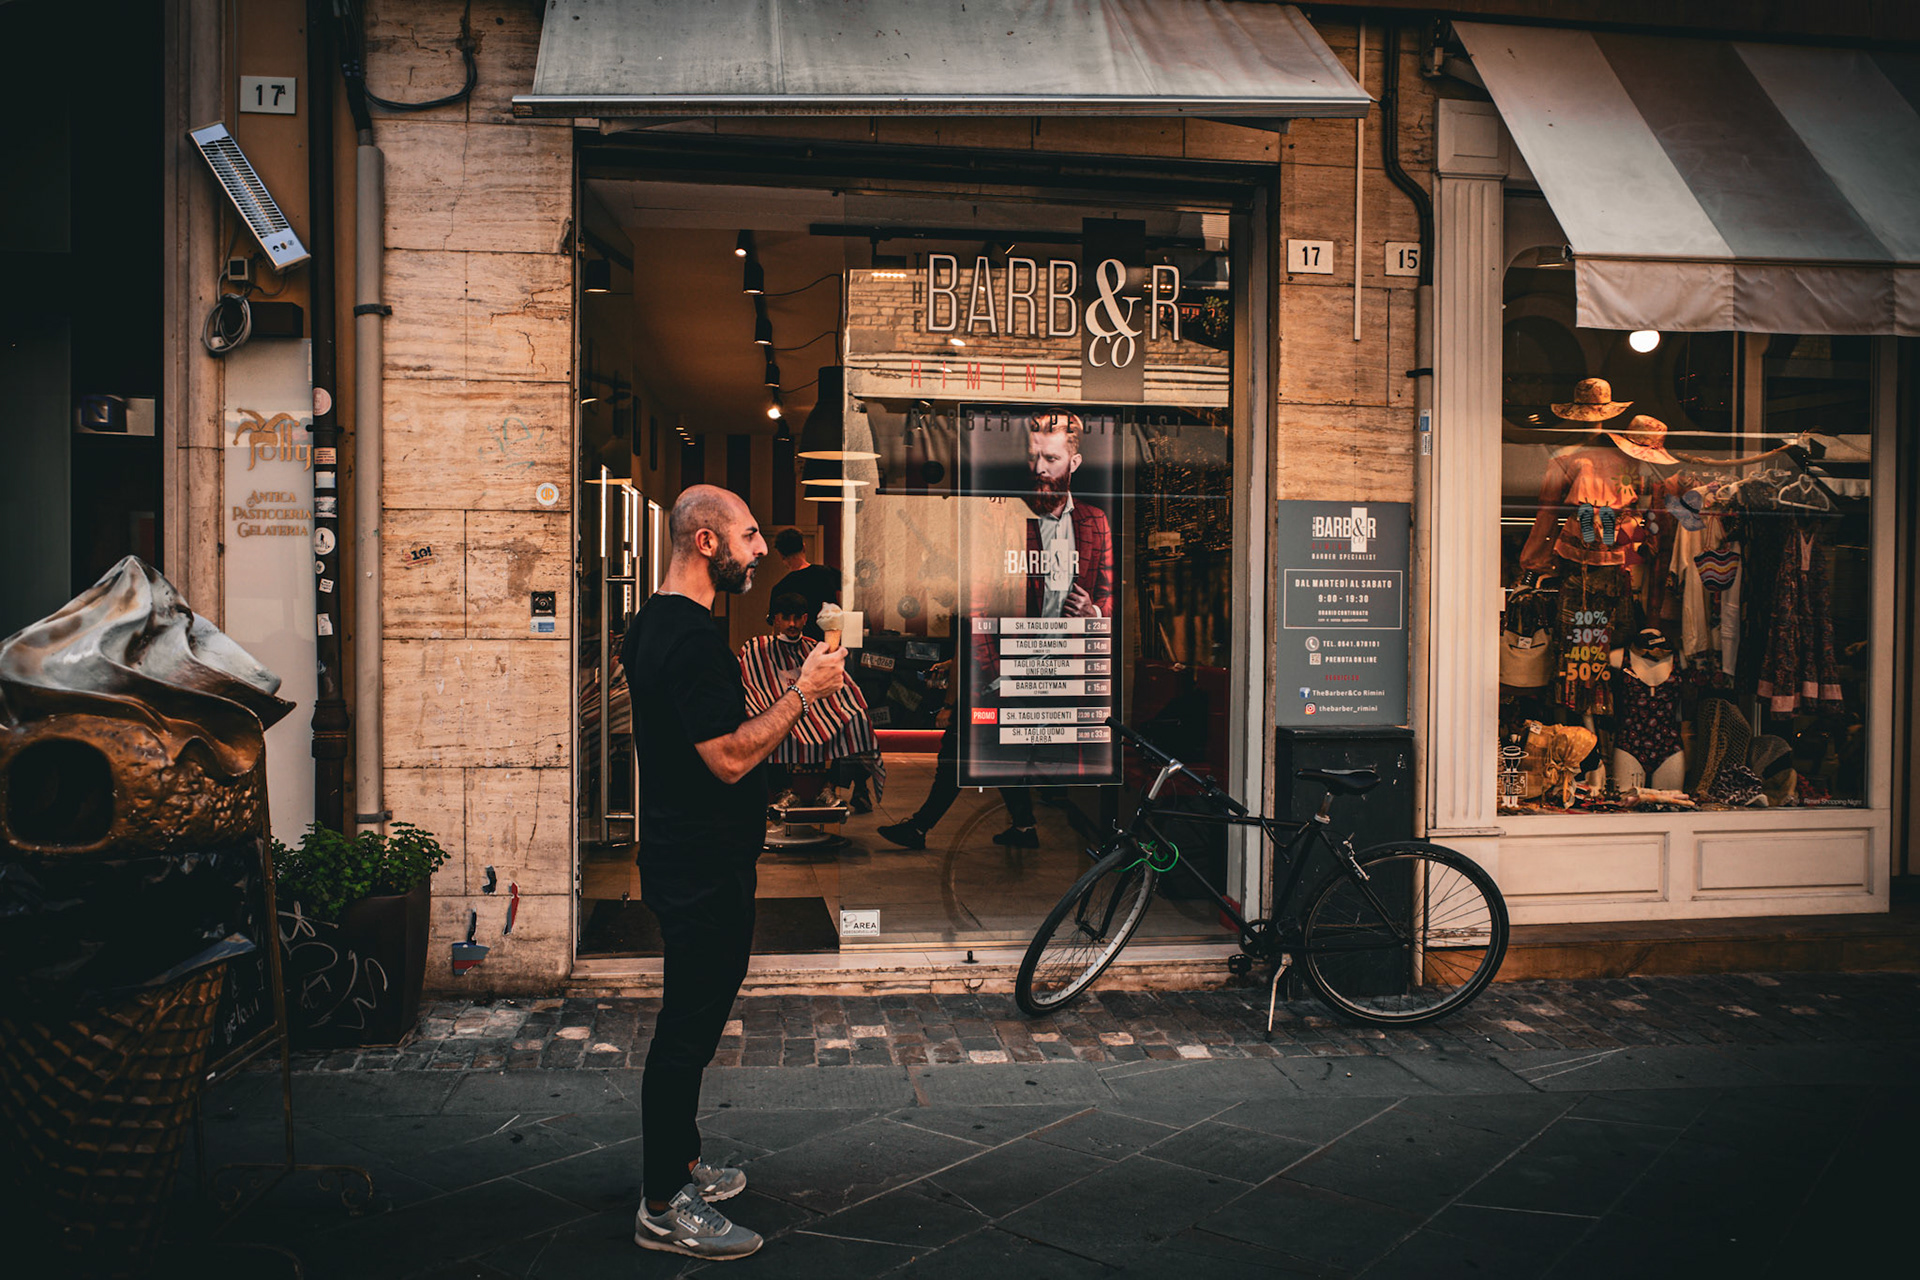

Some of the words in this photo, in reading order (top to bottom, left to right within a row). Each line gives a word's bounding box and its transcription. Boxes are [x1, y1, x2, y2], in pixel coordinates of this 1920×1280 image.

[1302, 246, 1320, 266] 17
[1398, 249, 1418, 269] 15
[910, 359, 1061, 393] RIMINI
[910, 408, 1011, 432] BARBER
[232, 506, 313, 521] PASTICCERIA
[237, 522, 308, 538] GELATERIA
[1339, 553, 1377, 561] SPECIALIST
[1295, 579, 1310, 588] DAL
[1312, 578, 1348, 588] MARTEDÌ
[1350, 580, 1360, 588] AL
[1361, 580, 1393, 588] SABATO
[1318, 594, 1337, 603] 9:00
[1345, 594, 1369, 603] 19:30
[1570, 611, 1608, 625] -20%
[978, 622, 992, 630] LUI
[1015, 622, 1025, 630] SH.
[1027, 622, 1049, 630] TAGLIO
[1050, 622, 1068, 630] UOMO
[1566, 628, 1609, 643] -30%
[1016, 640, 1037, 648] TAGLIO
[1039, 640, 1068, 648] BAMBINO
[1564, 646, 1607, 661] -40%
[1025, 667, 1057, 676] UNIFORME
[1559, 662, 1611, 681] -50%
[1015, 682, 1037, 690] BARBA
[1038, 682, 1067, 690] CITYMAN
[1319, 705, 1378, 713] thebarber_rimini
[973, 711, 996, 720] PROMO
[1006, 712, 1017, 720] SH.
[1019, 712, 1041, 720] TAGLIO
[1042, 711, 1072, 720] STUDENTI
[1012, 728, 1023, 736] SH.
[1024, 728, 1046, 736] TAGLIO
[1047, 728, 1065, 736] UOMO
[1030, 736, 1052, 744] BARBA
